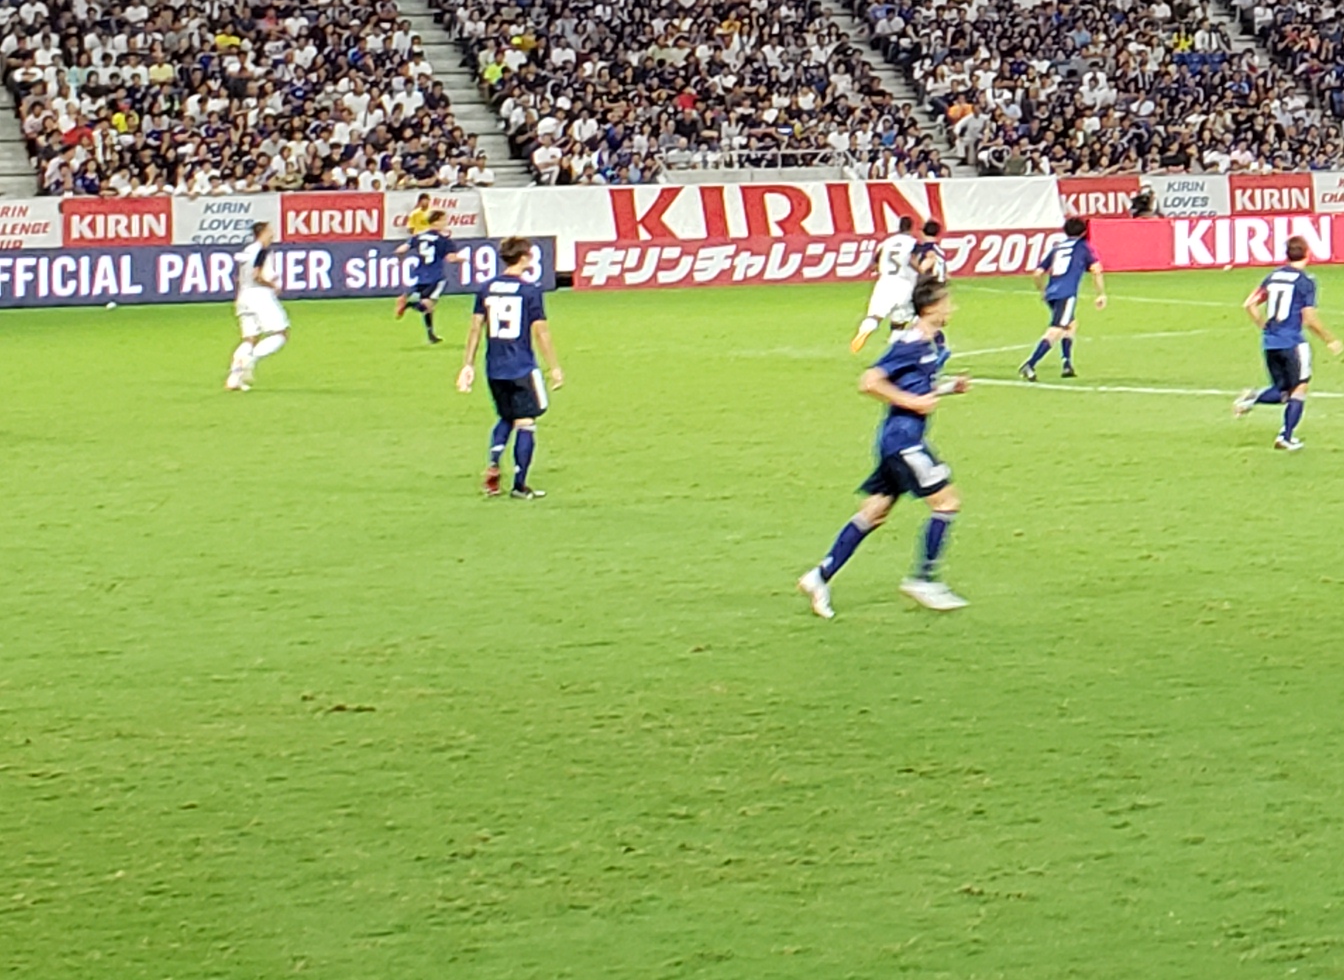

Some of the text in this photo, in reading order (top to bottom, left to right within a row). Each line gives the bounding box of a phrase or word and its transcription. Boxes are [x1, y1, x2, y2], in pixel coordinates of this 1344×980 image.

[1166, 181, 1205, 193] KIRIN
[1234, 188, 1310, 211] KIRIN
[203, 202, 252, 215] KIRIN
[609, 182, 947, 242] KIRIN
[1061, 191, 1137, 217] KIRIN
[1163, 196, 1209, 208] LOVES
[71, 213, 167, 240] KIRIN
[199, 218, 254, 231] LOVES
[287, 208, 379, 235] KIRIN
[1174, 216, 1332, 266] KIRIN
[888, 250, 901, 276] 5
[485, 295, 523, 339] 19
